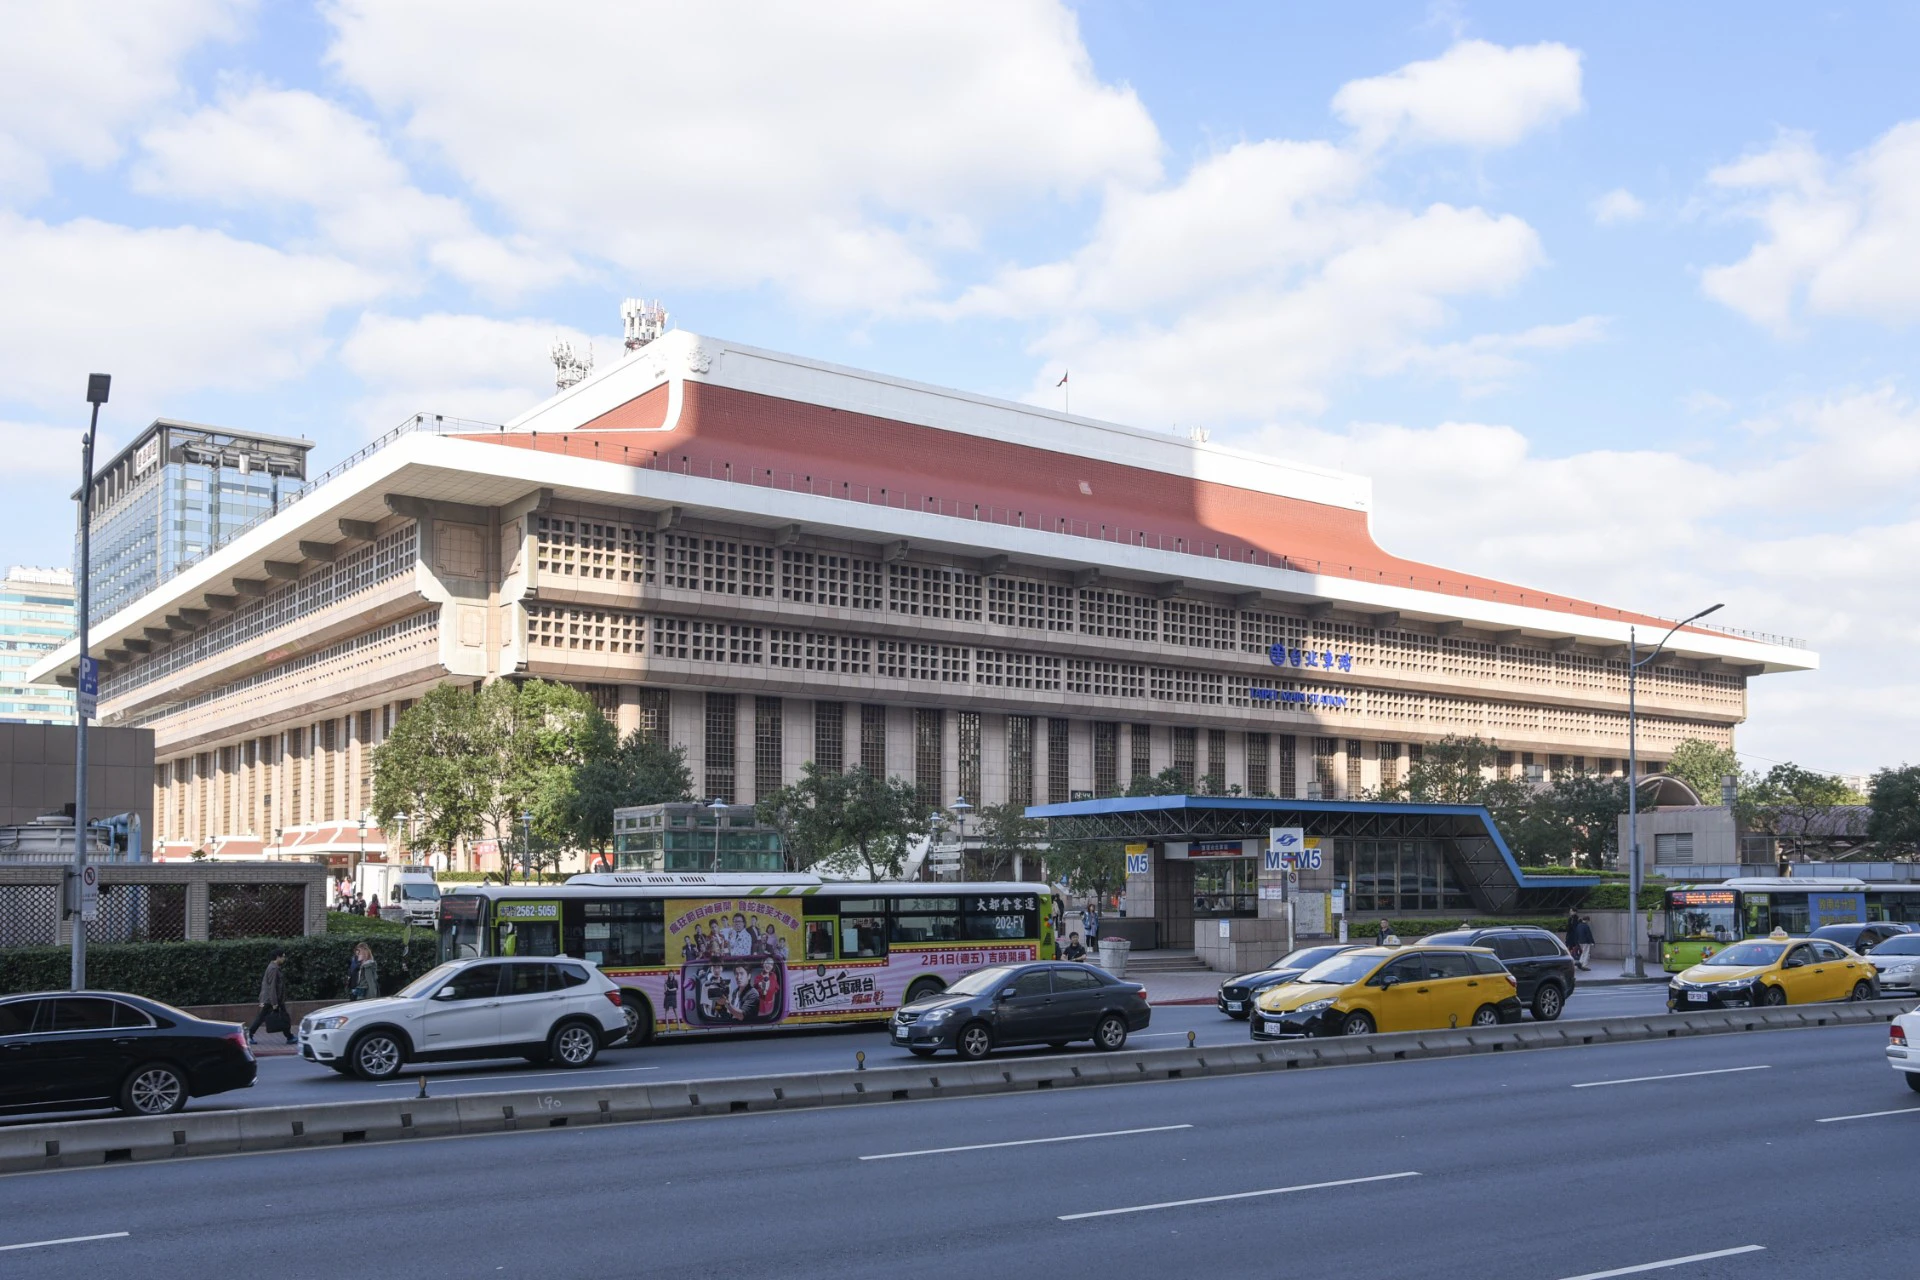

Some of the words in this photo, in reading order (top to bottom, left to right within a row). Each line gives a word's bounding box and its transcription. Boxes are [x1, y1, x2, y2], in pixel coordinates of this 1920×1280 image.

[82, 658, 91, 679] P
[1290, 648, 1351, 672] 台北車站
[1250, 688, 1278, 701] TAIPEI
[1281, 690, 1305, 703] MAIN
[1308, 693, 1347, 706] STATION
[1127, 855, 1148, 872] M5
[1295, 849, 1321, 869] M5
[516, 905, 557, 917] 2562-5059
[976, 897, 1036, 912] 大都會客運
[995, 915, 1025, 930] 202-FY
[921, 952, 984, 966] 2月1日(週五)
[989, 951, 1027, 963] 吉時開播
